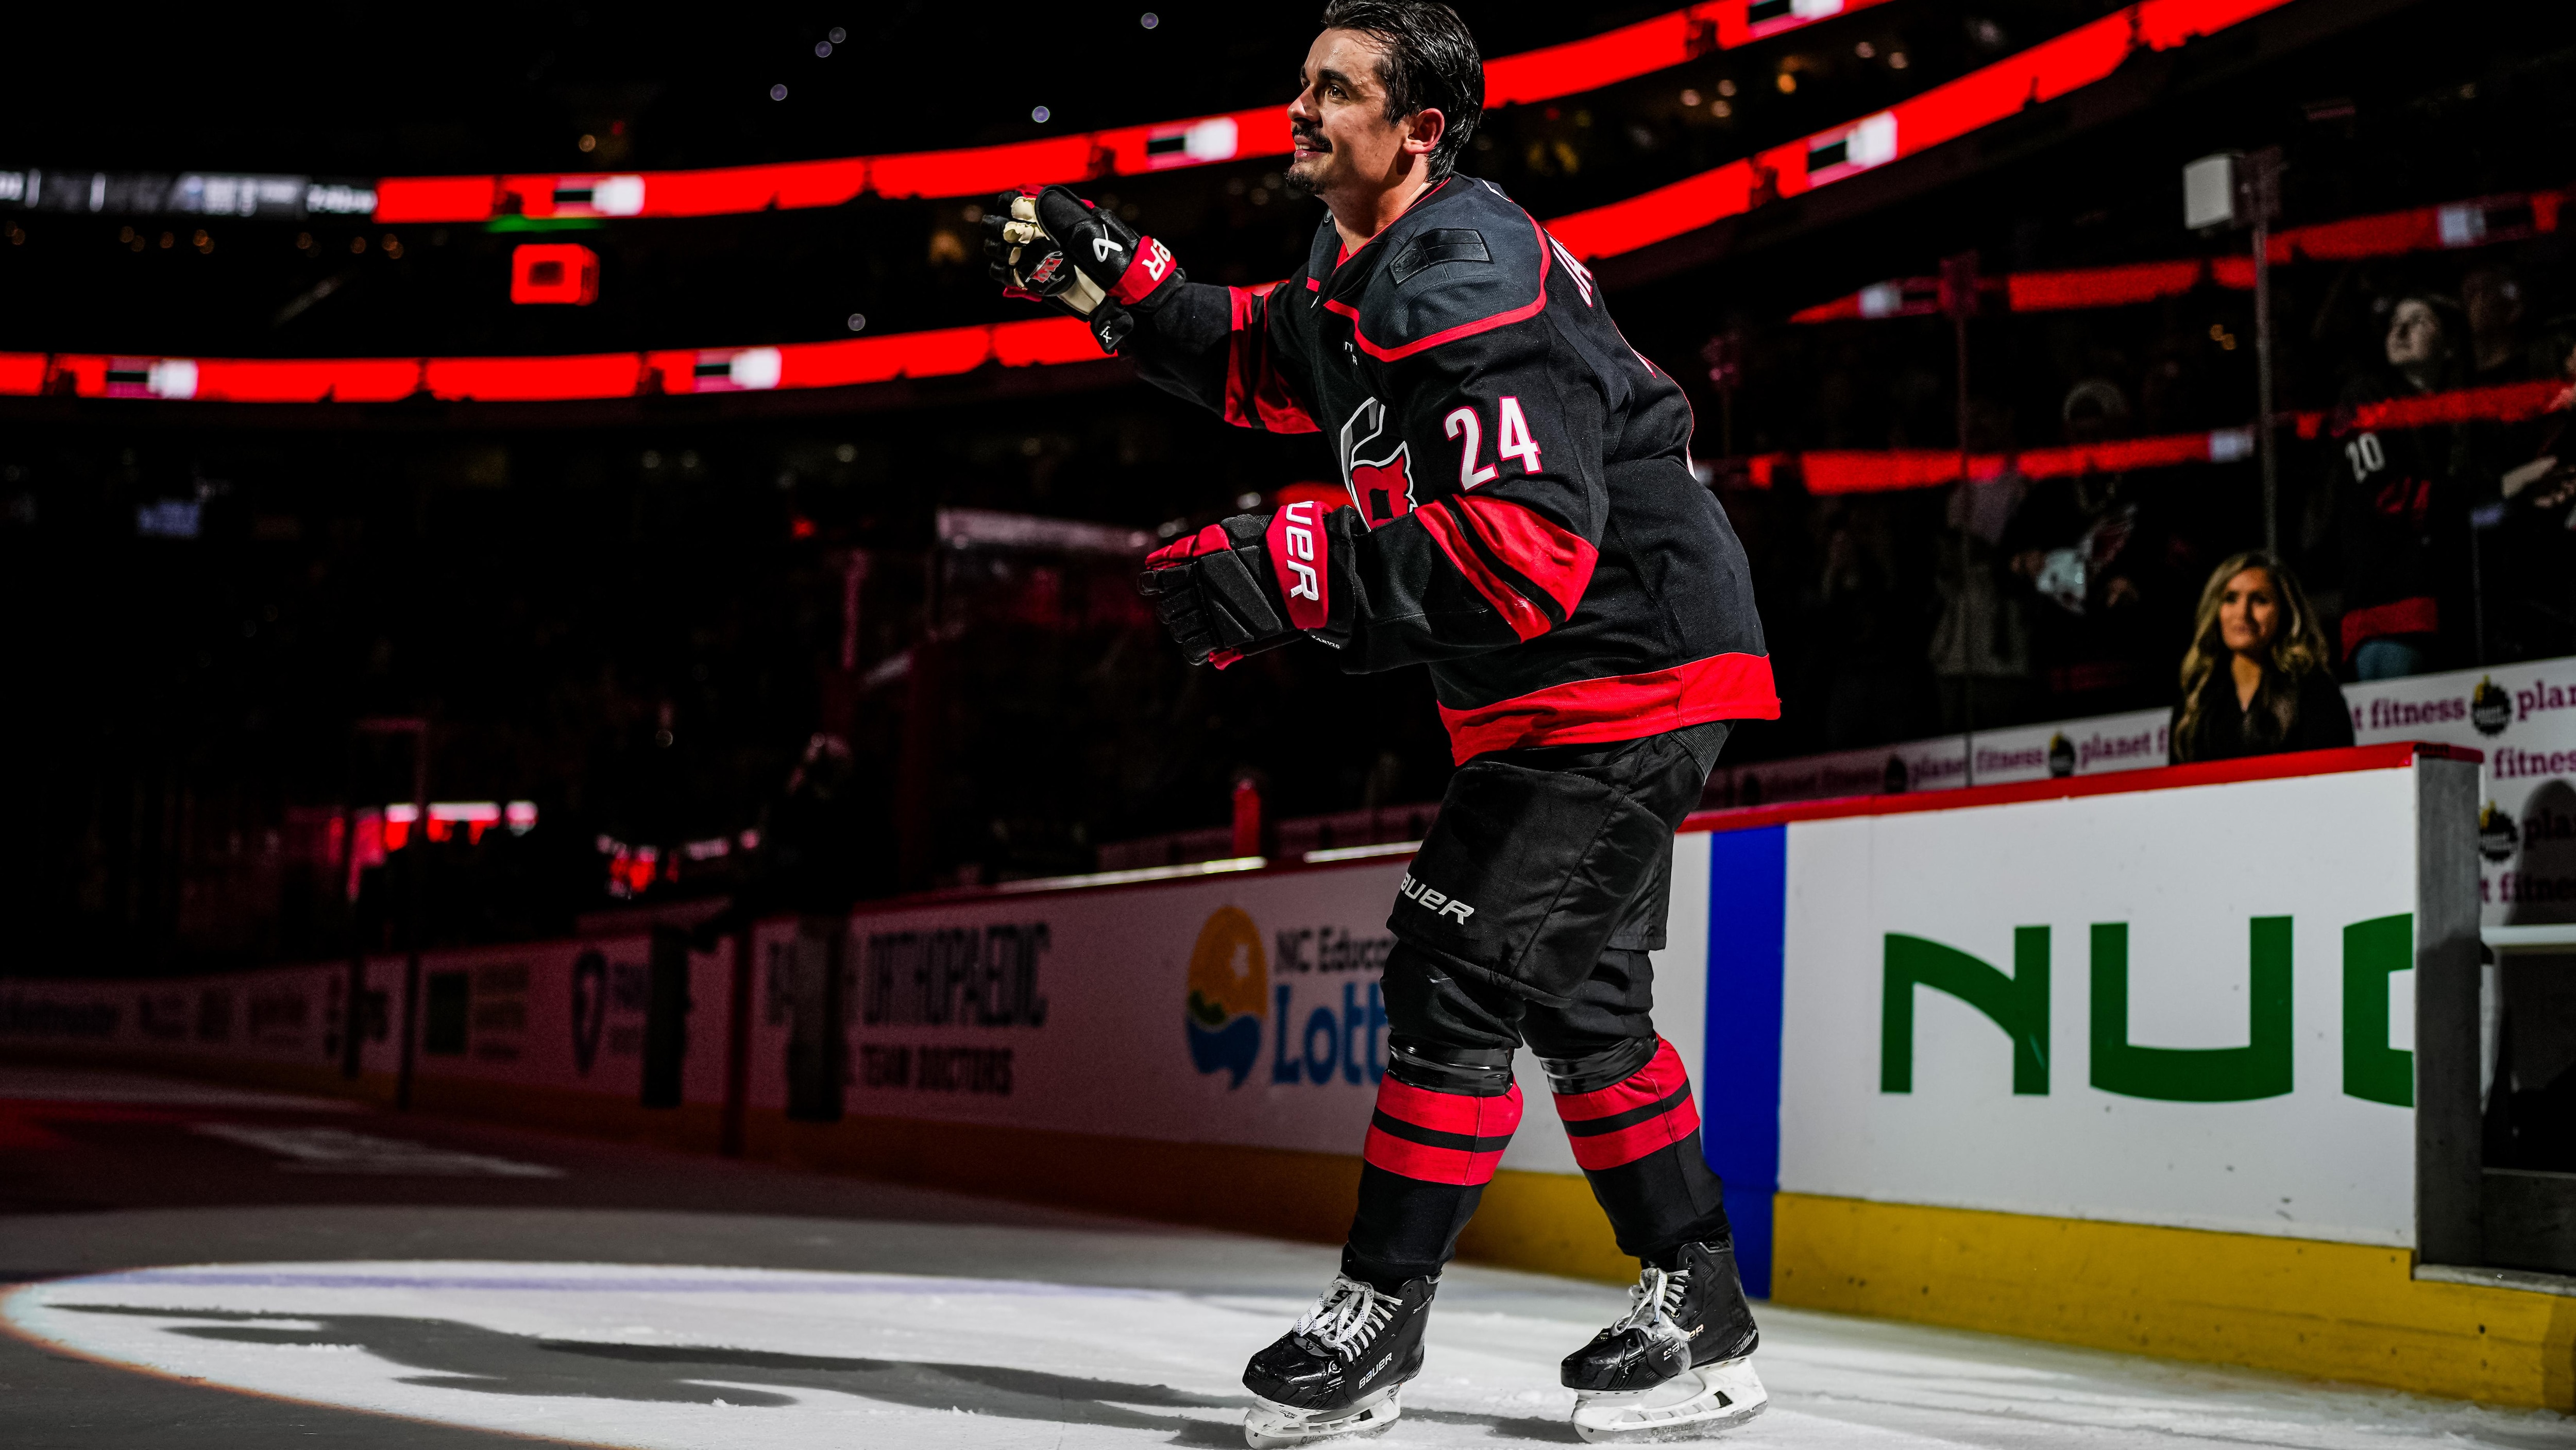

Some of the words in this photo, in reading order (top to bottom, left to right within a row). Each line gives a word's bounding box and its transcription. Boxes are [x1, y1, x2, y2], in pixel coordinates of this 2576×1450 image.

[1443, 396, 1544, 493] 24
[2371, 697, 2466, 729] fitness
[1400, 872, 1475, 925] AUER
[1276, 930, 1311, 974] NC
[1359, 1352, 1393, 1390] BAUER
